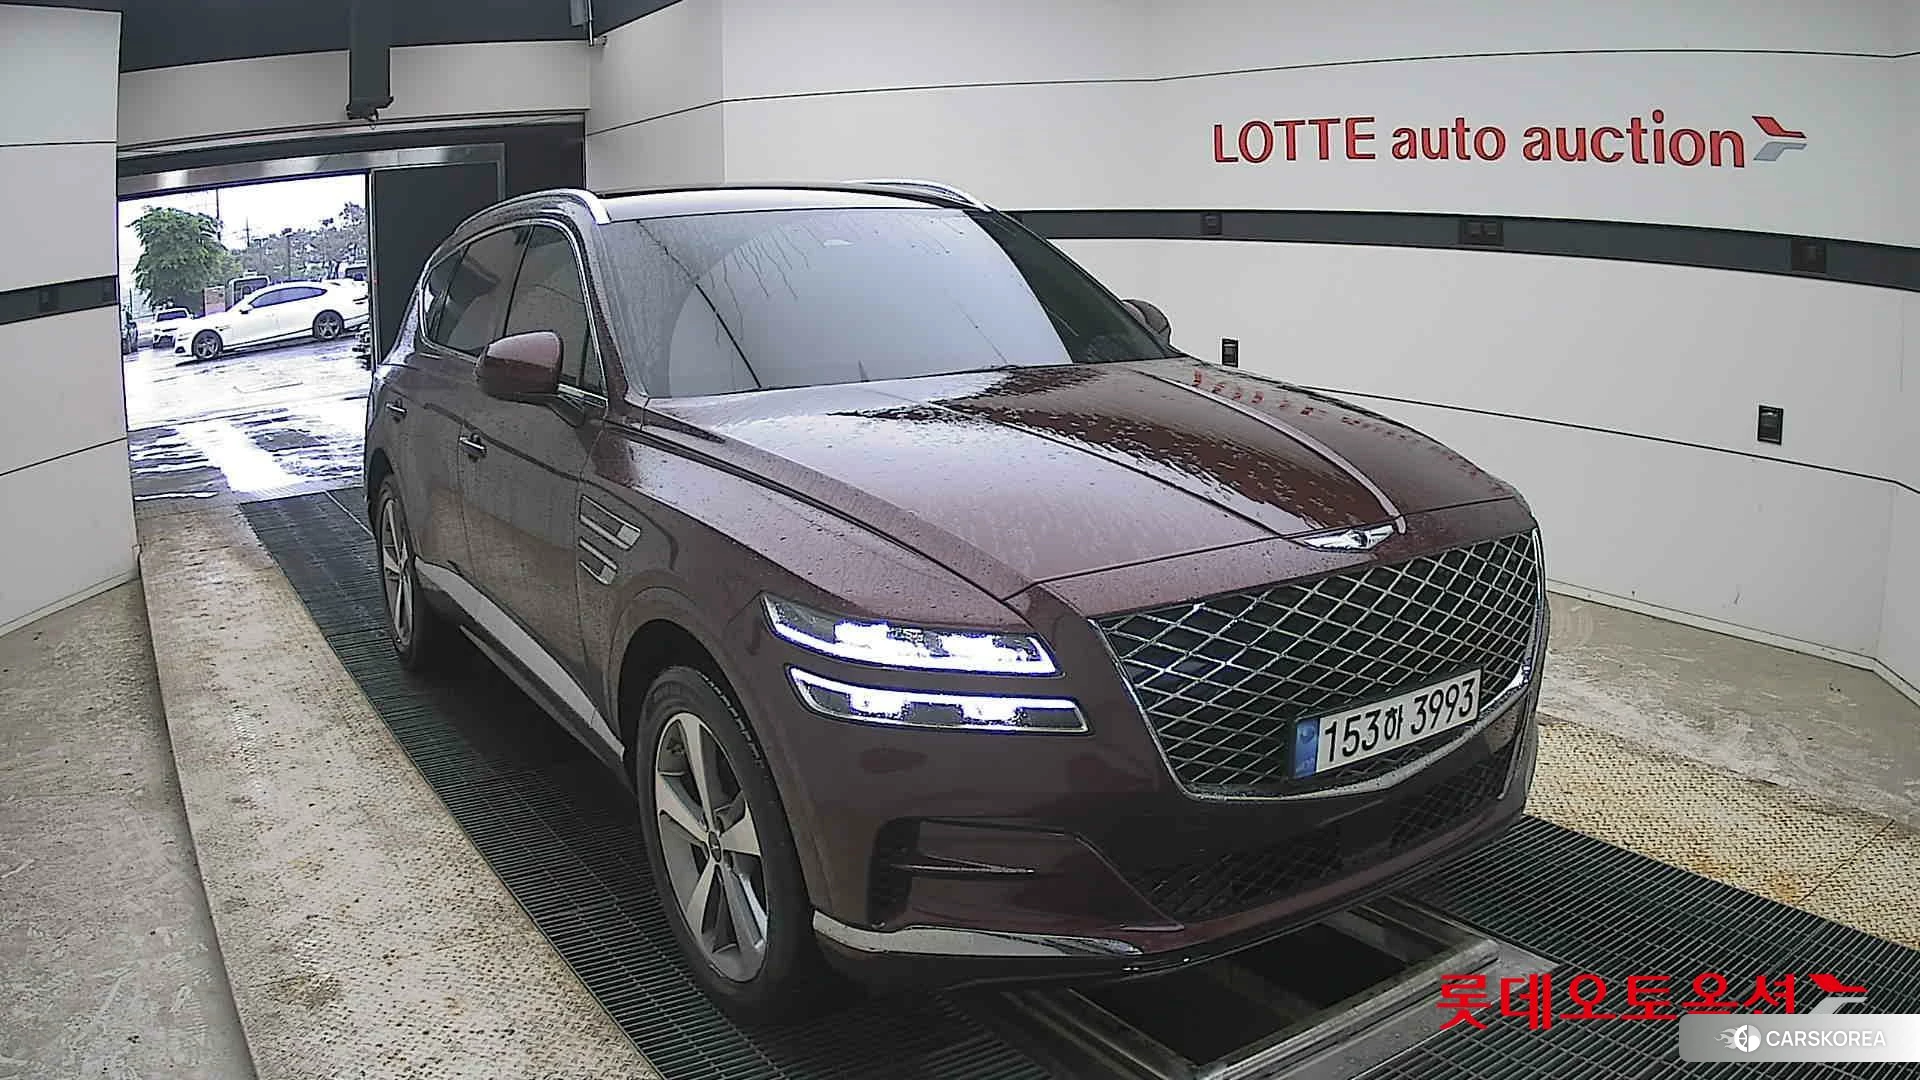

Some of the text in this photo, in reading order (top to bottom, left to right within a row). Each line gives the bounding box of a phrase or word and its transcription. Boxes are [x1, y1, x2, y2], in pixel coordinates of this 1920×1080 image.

[1213, 109, 1745, 168] LOTTE auto auction
[1324, 677, 1476, 763] 153하 3993
